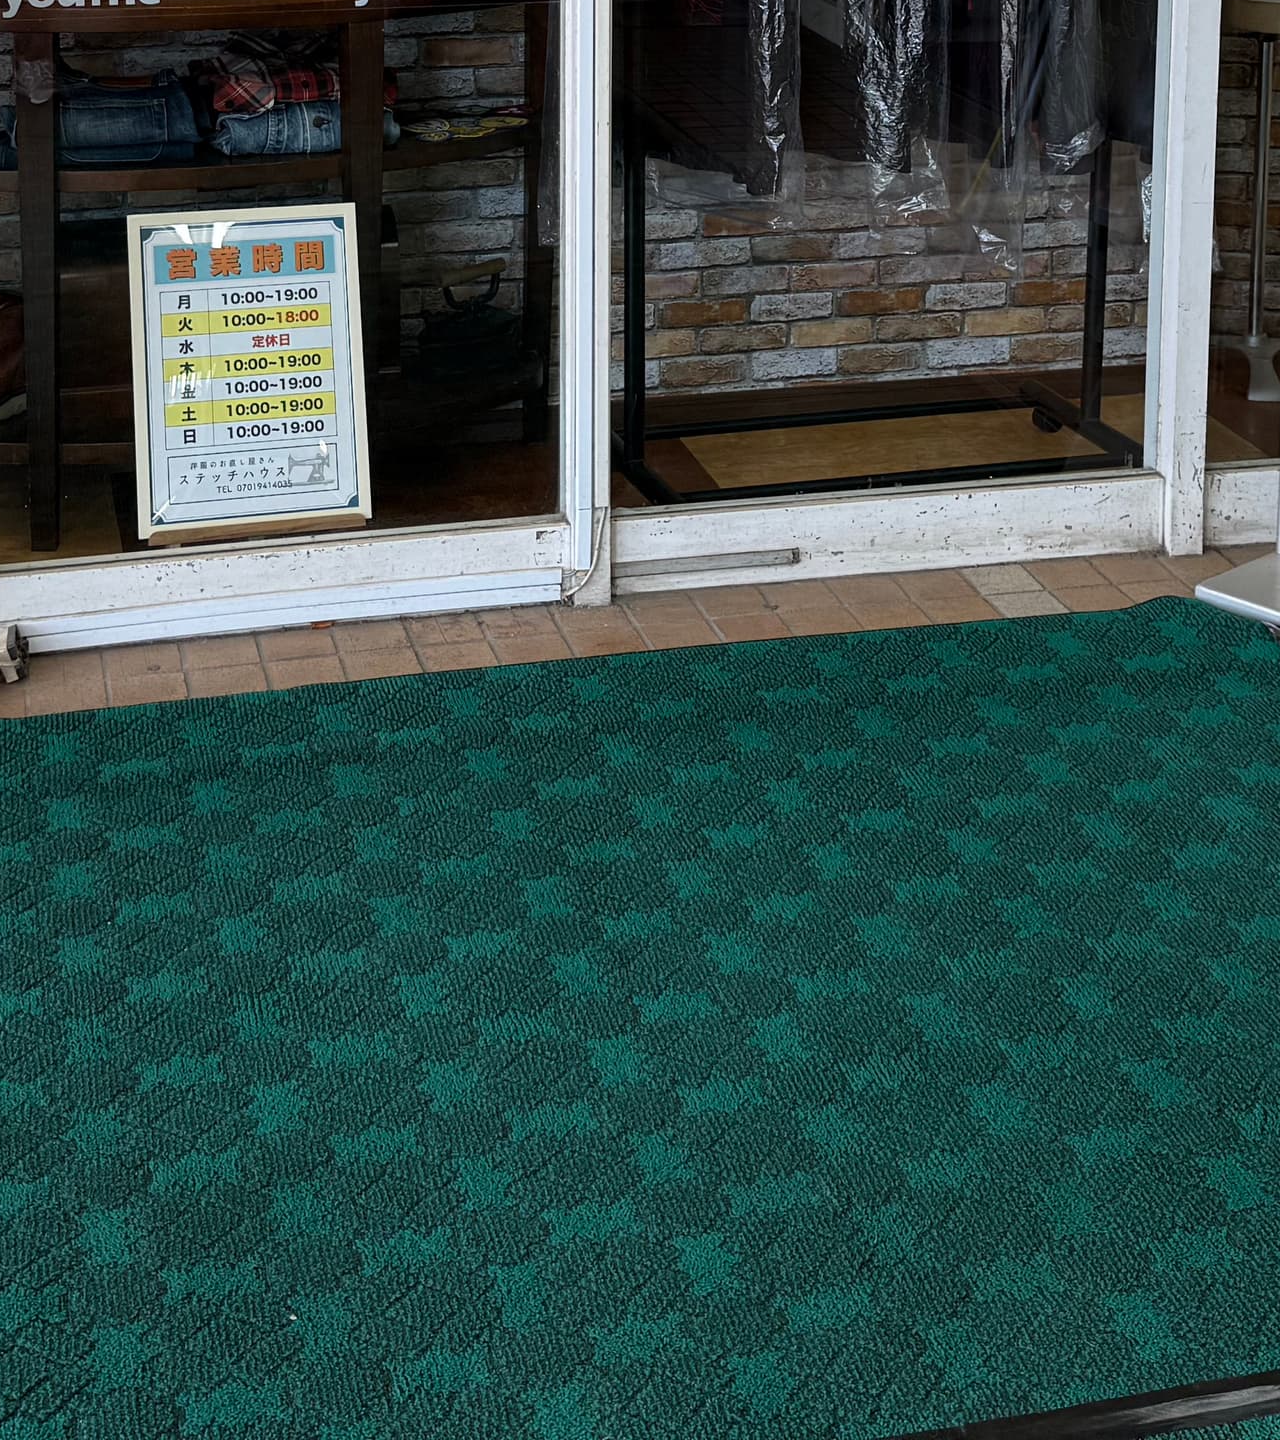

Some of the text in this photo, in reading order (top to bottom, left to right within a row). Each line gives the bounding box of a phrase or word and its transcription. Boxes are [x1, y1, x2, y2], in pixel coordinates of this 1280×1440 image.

[166, 240, 326, 281] 営業時間
[177, 294, 192, 310] 月
[178, 317, 194, 332] 火
[179, 333, 291, 355] 水 定休日
[180, 361, 196, 375] 木
[181, 406, 197, 422] 土
[183, 428, 197, 444] 日
[179, 466, 286, 486] ステッチハウス
[216, 485, 233, 494] TEL
